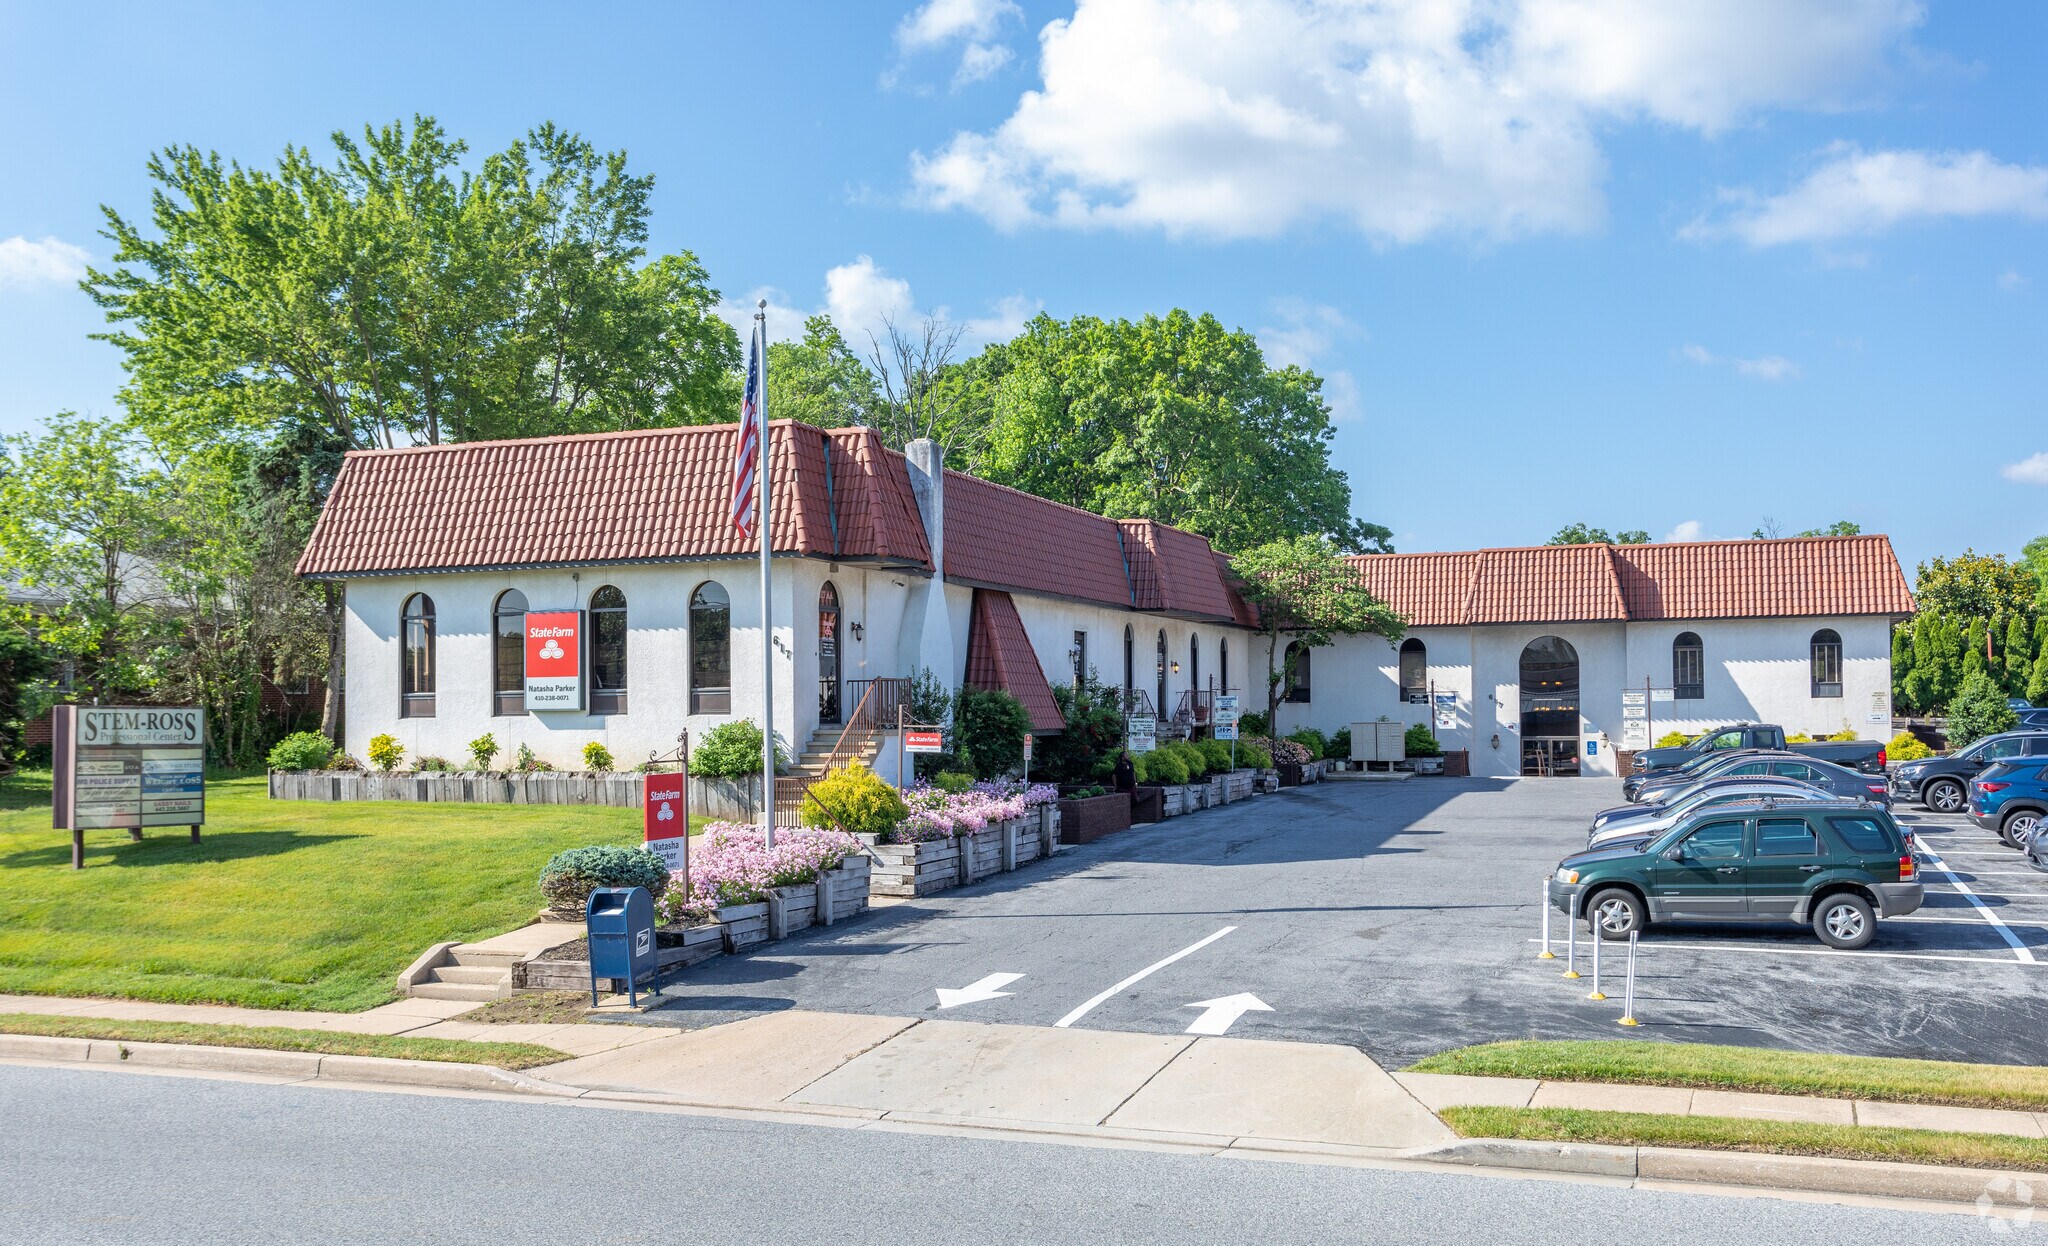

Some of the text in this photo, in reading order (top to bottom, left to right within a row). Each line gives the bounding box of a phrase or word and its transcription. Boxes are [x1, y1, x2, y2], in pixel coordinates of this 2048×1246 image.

[555, 684, 576, 692] Parker
[85, 712, 196, 741] STEM-ROSS
[100, 731, 183, 741] Professional Center
[144, 775, 202, 785] WEIGHT LOSS
[653, 841, 679, 852] Natasha
